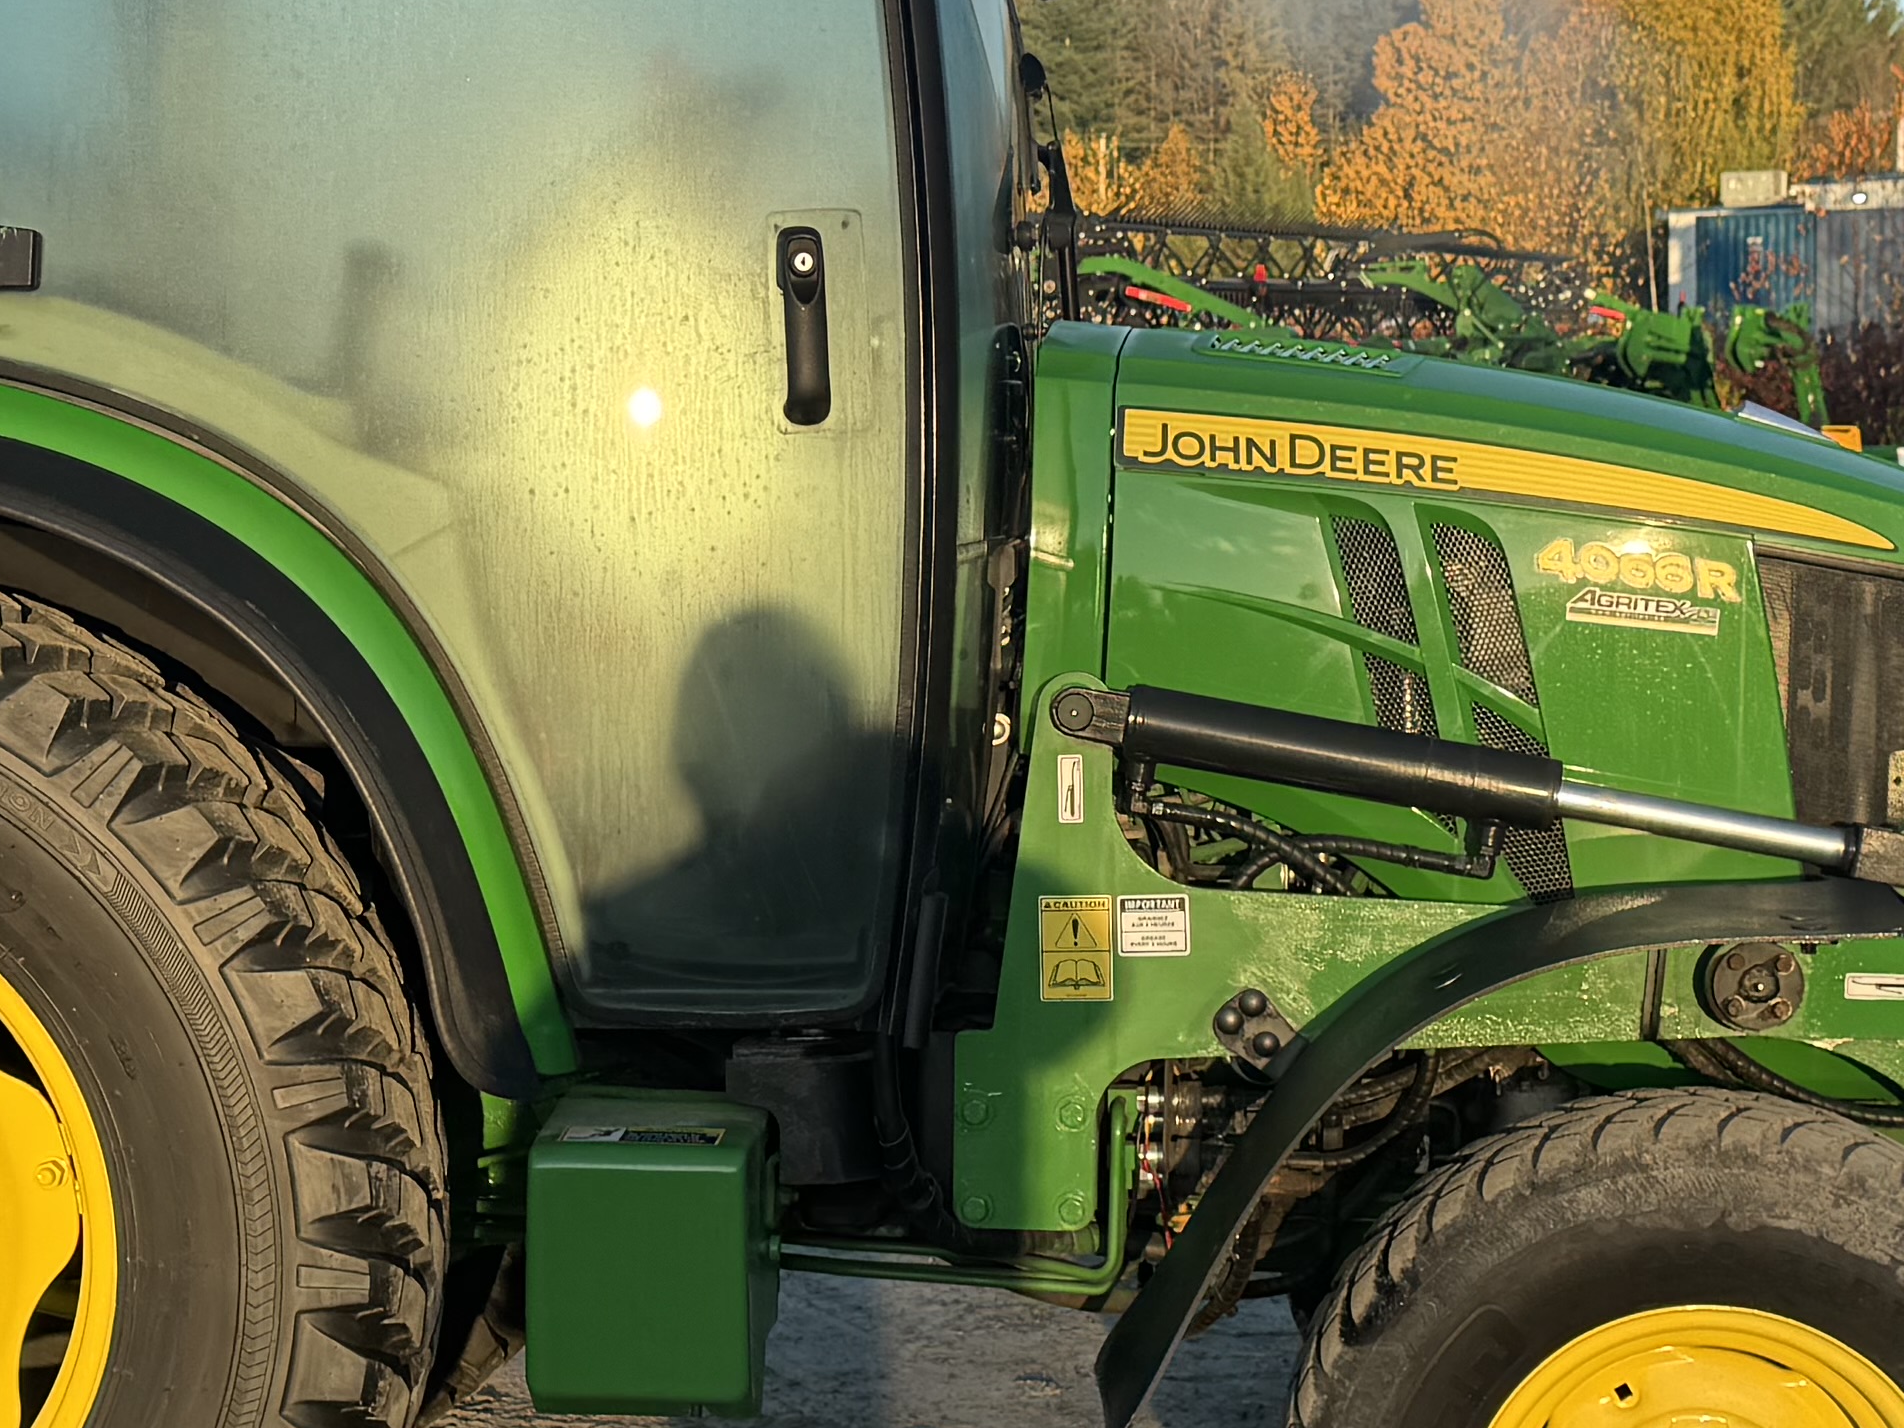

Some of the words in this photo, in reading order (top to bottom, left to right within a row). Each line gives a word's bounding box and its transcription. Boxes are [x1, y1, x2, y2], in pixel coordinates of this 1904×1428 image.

[1143, 423, 1278, 469] JOHN
[1289, 433, 1460, 486] DEERE
[1535, 538, 1742, 603] 4066R
[1570, 588, 1692, 616] AGRITEX
[1054, 900, 1106, 909] CAUTION
[1124, 898, 1181, 911] IMPORTANT
